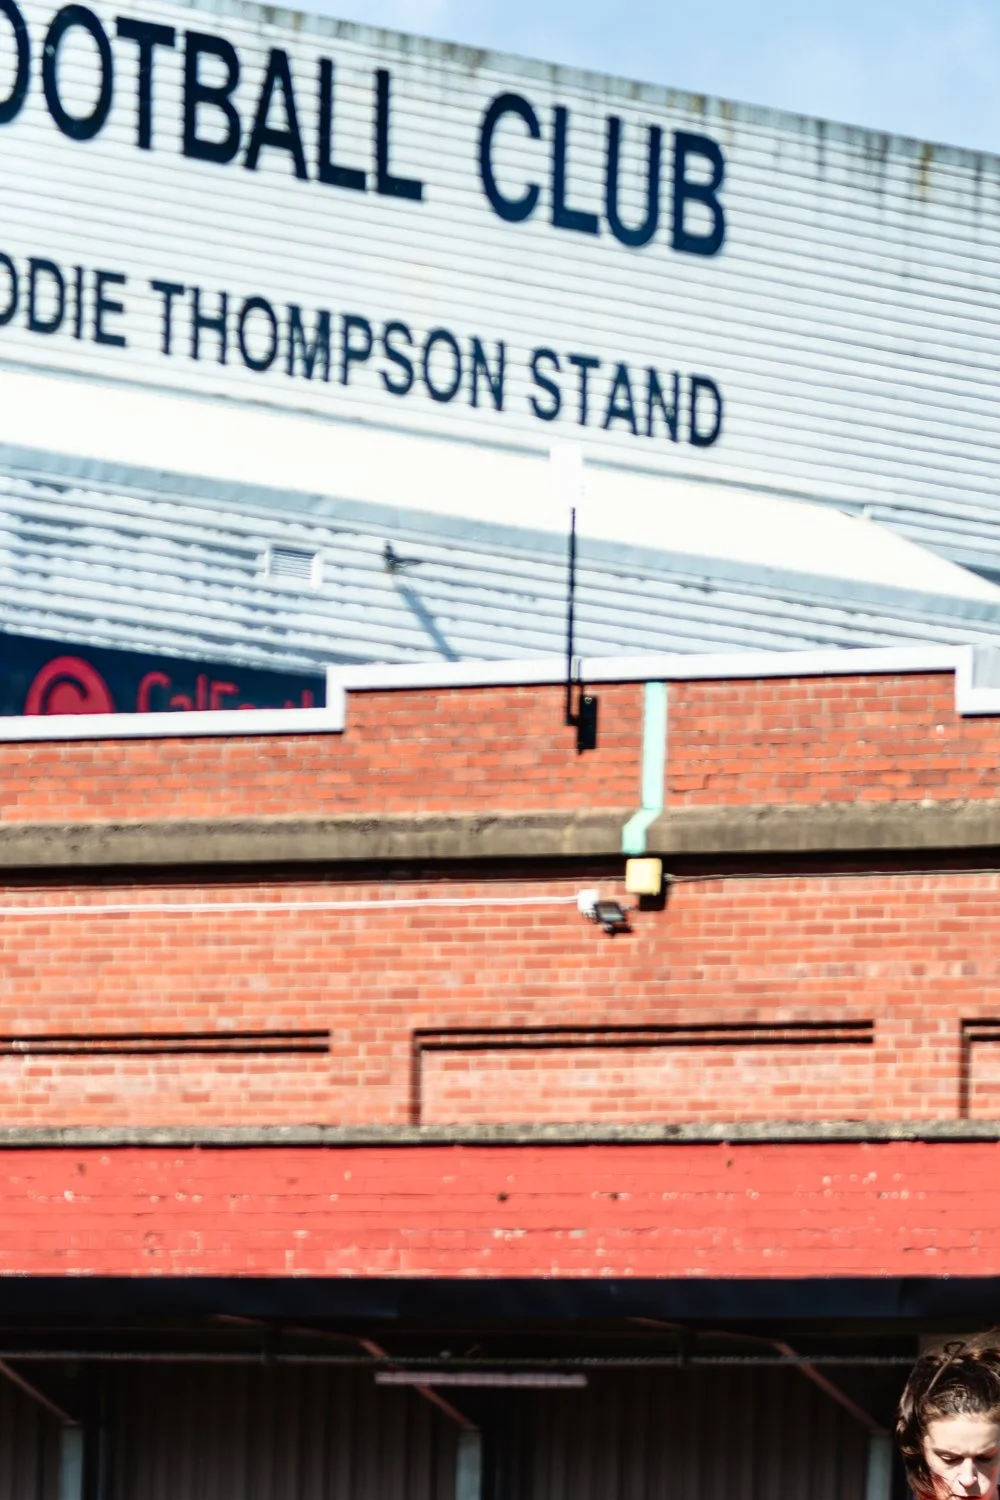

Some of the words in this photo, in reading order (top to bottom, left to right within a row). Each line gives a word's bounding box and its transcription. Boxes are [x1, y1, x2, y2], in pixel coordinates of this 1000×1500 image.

[479, 92, 726, 257] CLUB
[149, 279, 505, 412] THOMPSON
[528, 347, 724, 448] STAND
